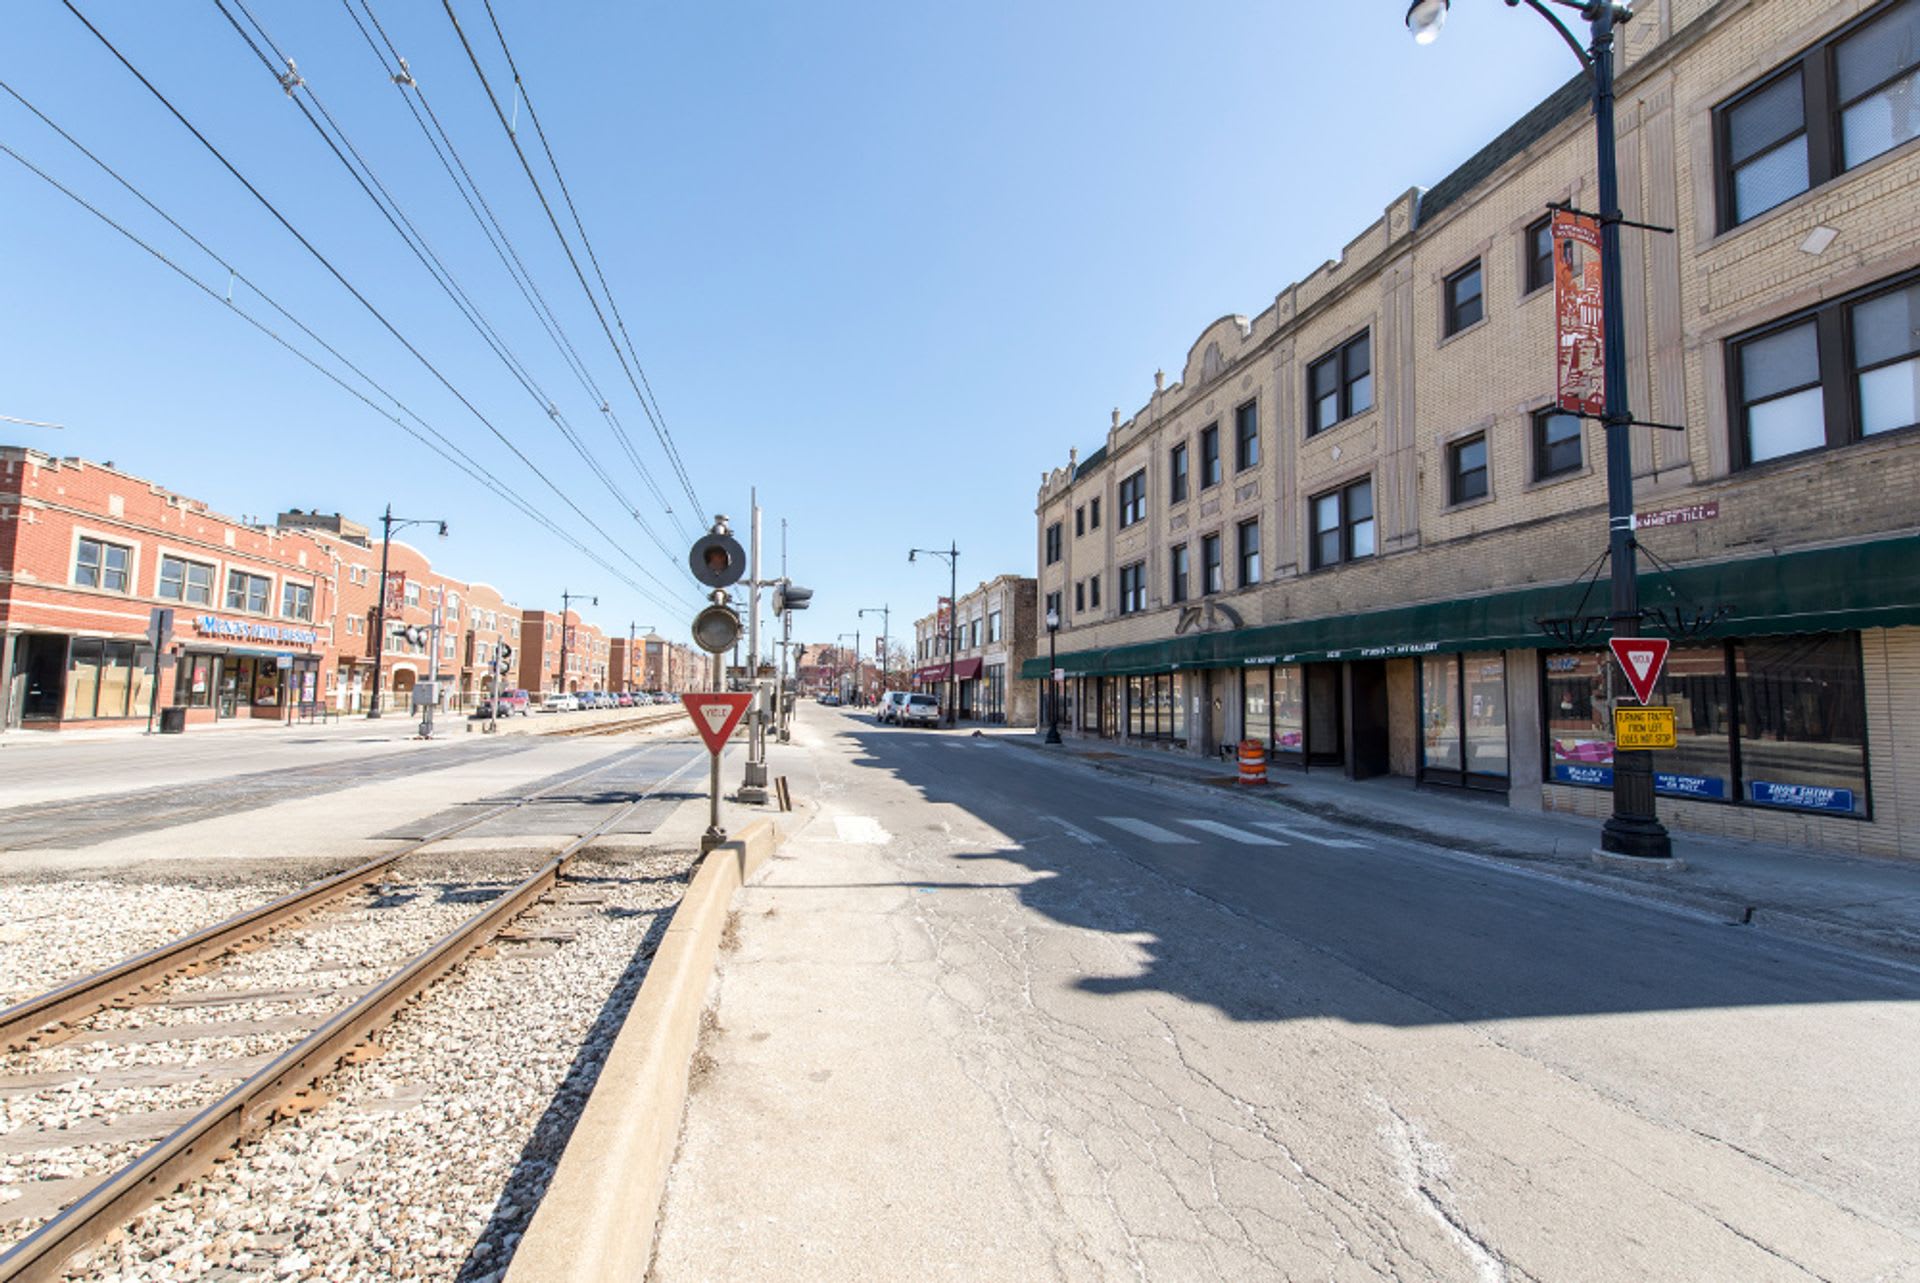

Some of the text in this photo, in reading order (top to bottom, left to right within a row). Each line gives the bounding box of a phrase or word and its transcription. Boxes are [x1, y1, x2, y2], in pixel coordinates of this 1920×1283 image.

[1682, 506, 1705, 520] TILL
[705, 708, 727, 717] YIELD
[1628, 722, 1663, 732] FROM LEFT
[1620, 734, 1671, 744] DOES NOT STOP
